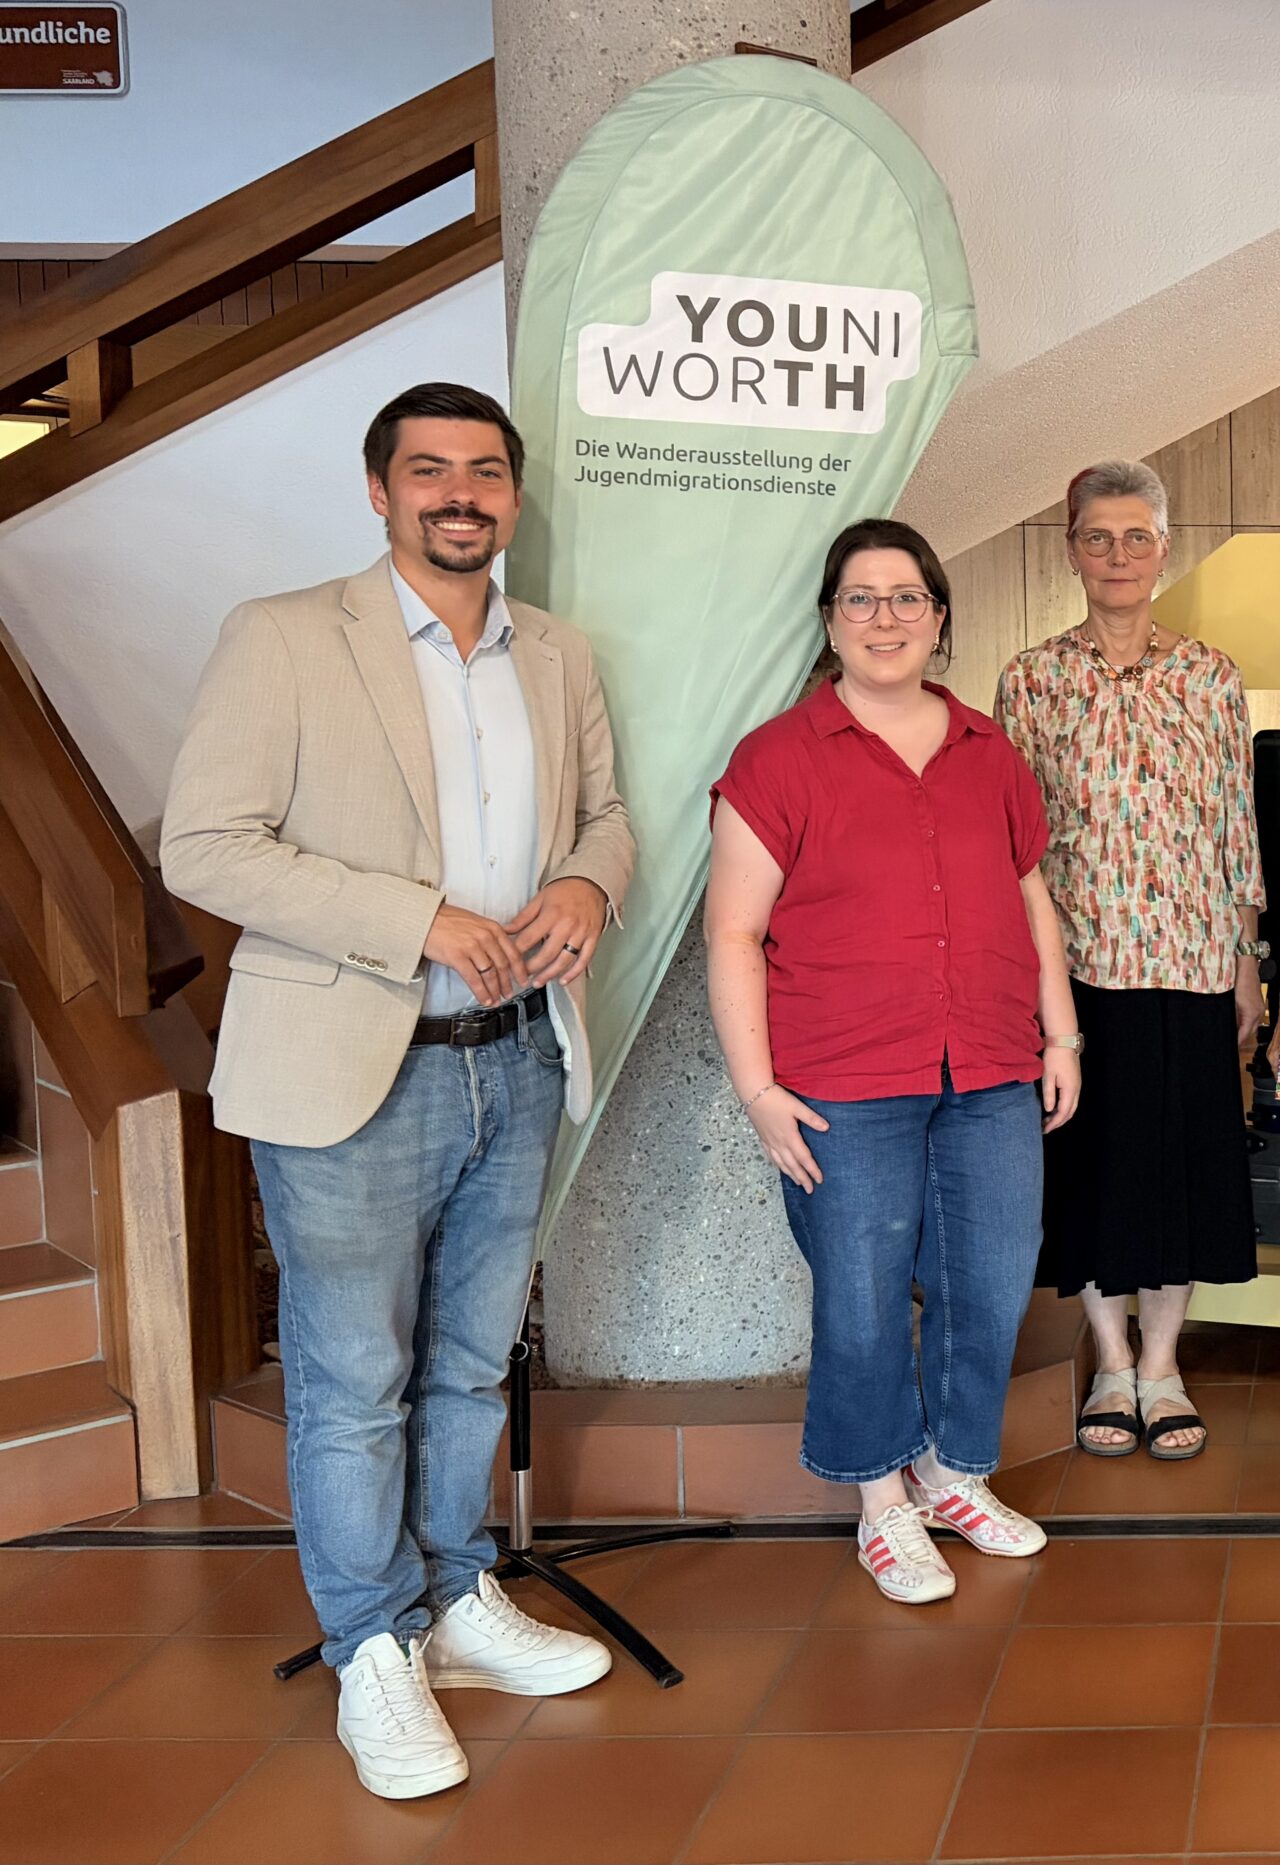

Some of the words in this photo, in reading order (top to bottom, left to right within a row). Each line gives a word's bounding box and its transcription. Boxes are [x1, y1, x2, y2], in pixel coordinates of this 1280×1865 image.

[0, 21, 111, 44] undliche
[676, 295, 900, 358] YOUNI
[602, 346, 865, 411] WORTH
[575, 439, 609, 457] Die
[616, 441, 813, 473] Wanderausstellung
[819, 453, 852, 472] der
[574, 465, 836, 496] Jugendmigrationsdienste
